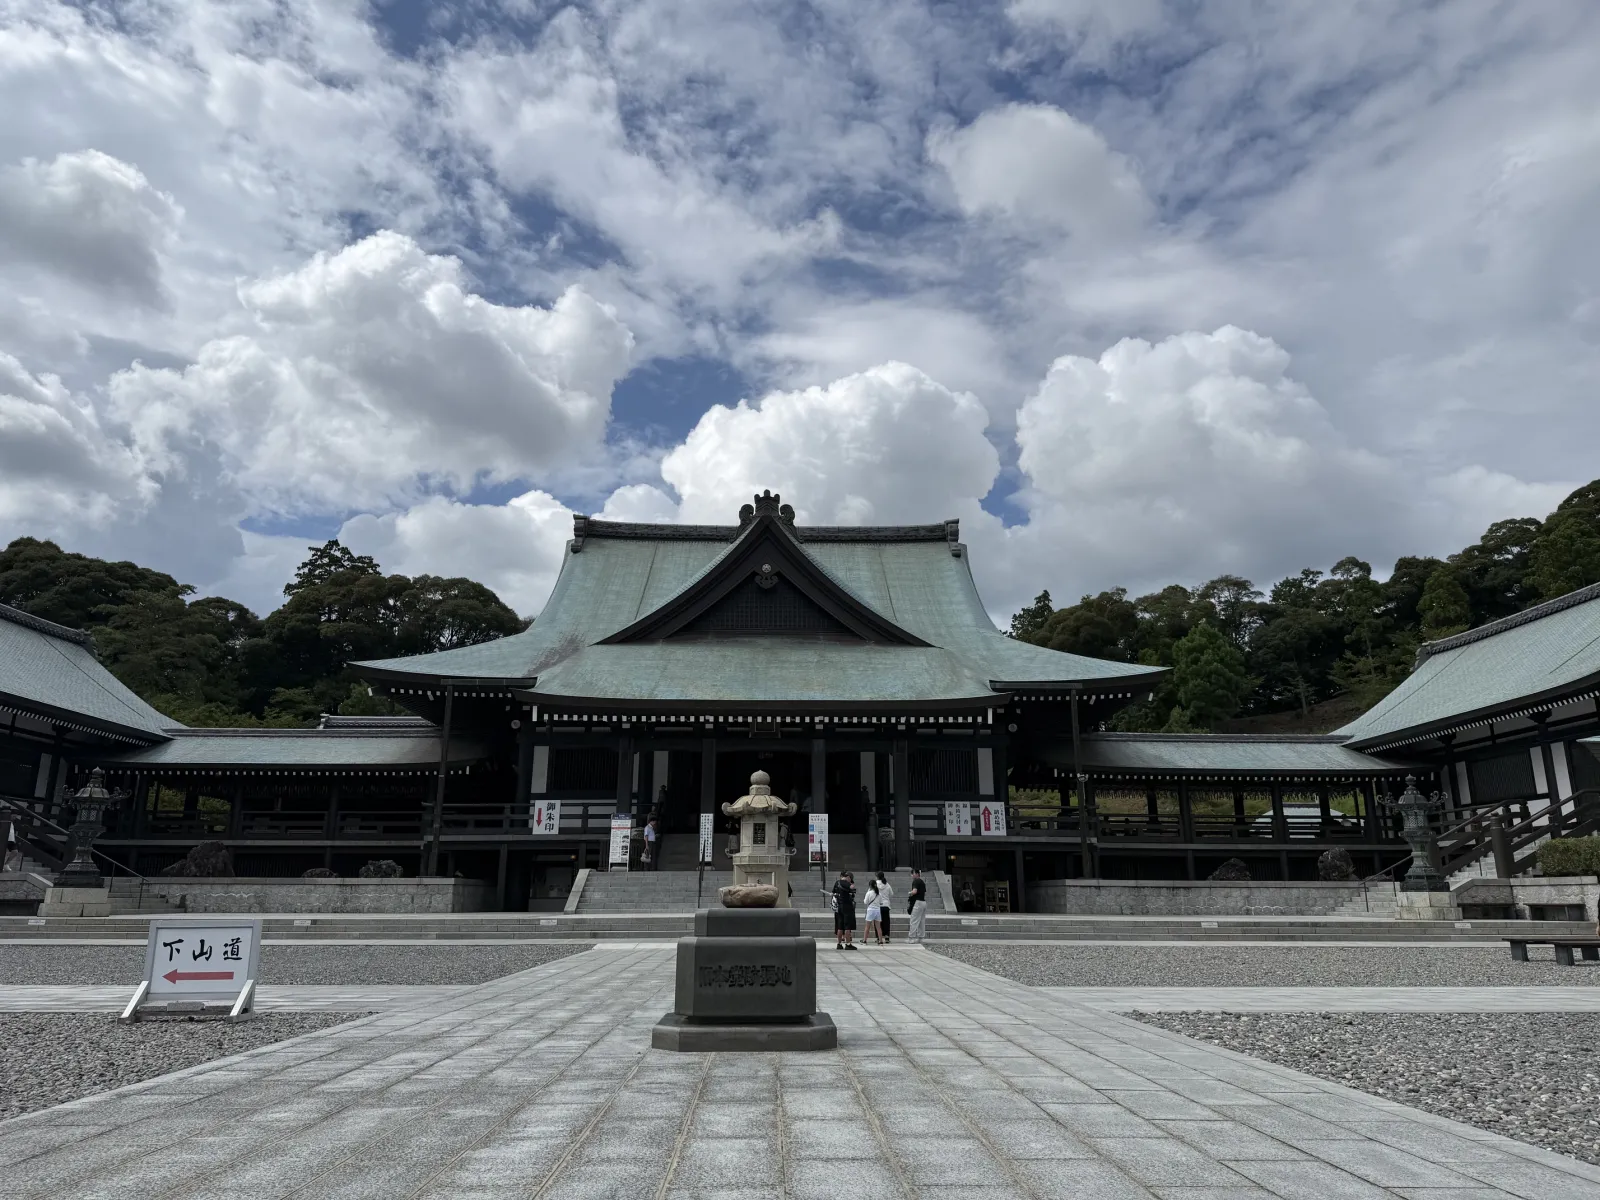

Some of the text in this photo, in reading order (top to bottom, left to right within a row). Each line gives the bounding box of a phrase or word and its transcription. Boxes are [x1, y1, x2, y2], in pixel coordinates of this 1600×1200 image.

[545, 802, 557, 832] 御朱印
[162, 937, 243, 962] 下山道
